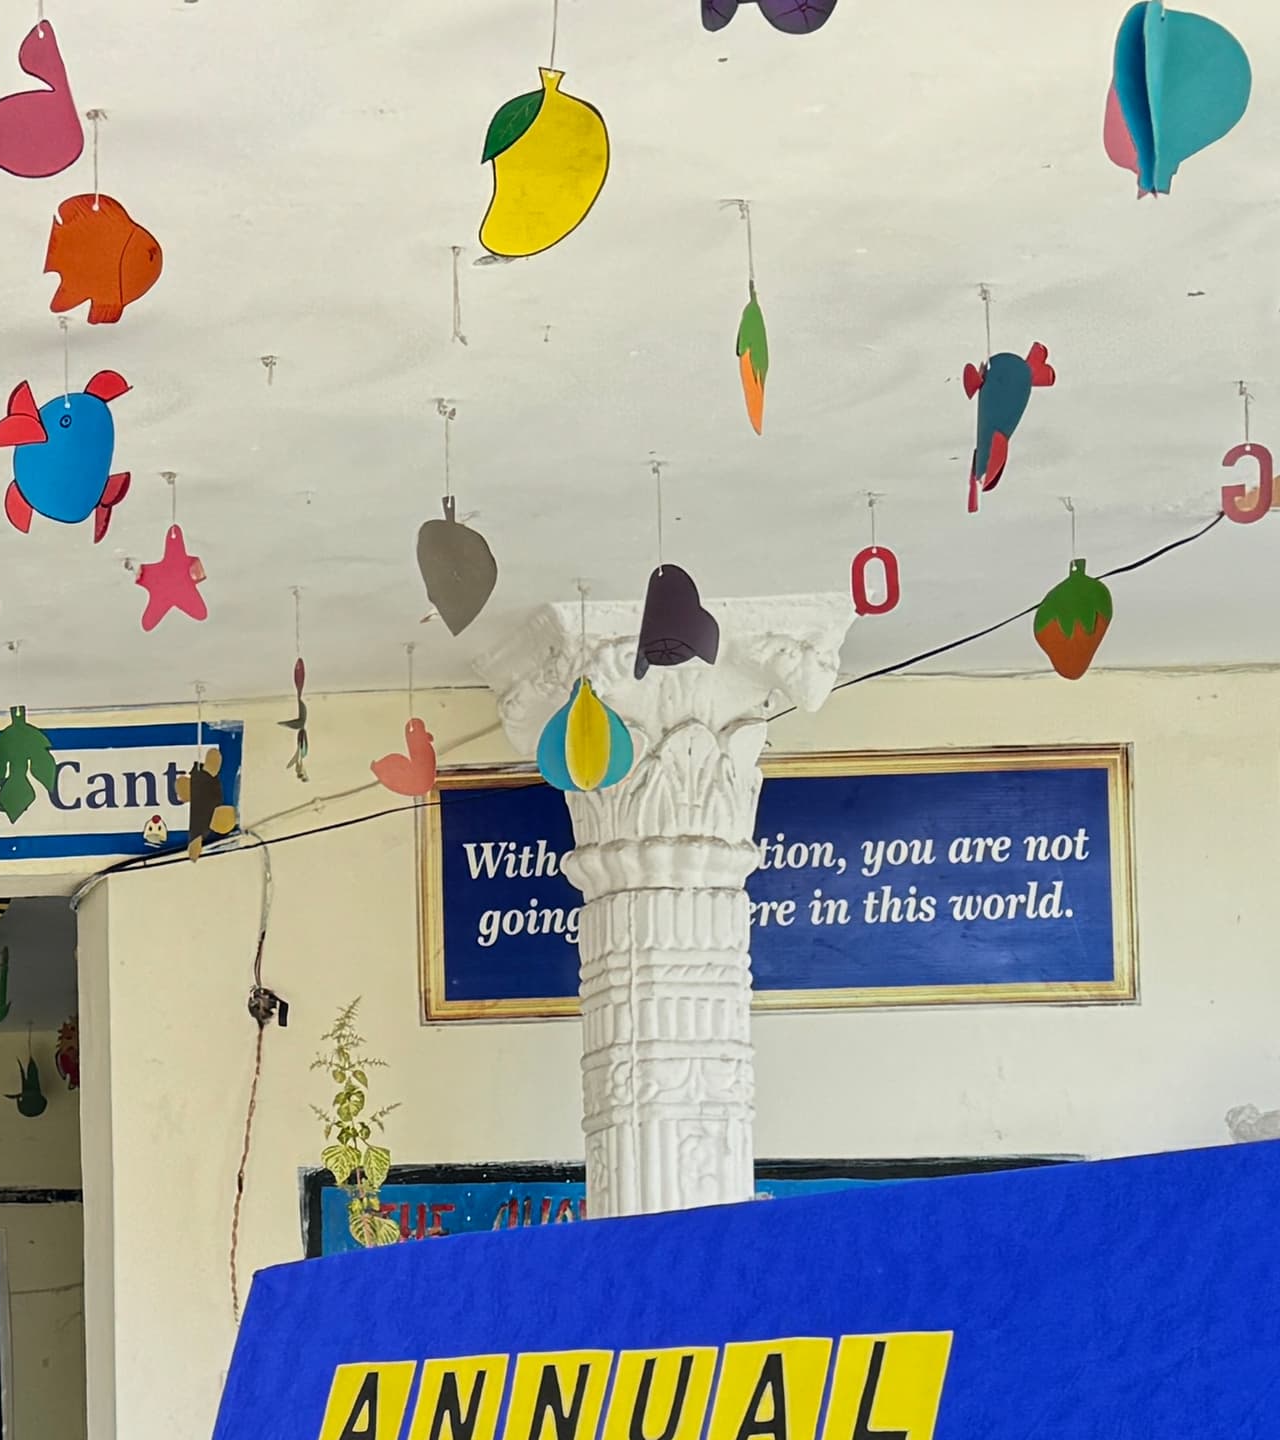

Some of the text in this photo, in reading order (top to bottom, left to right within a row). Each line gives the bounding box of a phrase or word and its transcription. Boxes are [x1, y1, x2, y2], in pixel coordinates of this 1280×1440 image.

[463, 840, 568, 880] With
[860, 837, 937, 877] you
[948, 835, 1012, 864] are
[1023, 828, 1090, 862] not
[809, 889, 851, 926] in
[863, 886, 937, 924] this
[948, 880, 1074, 922] world.
